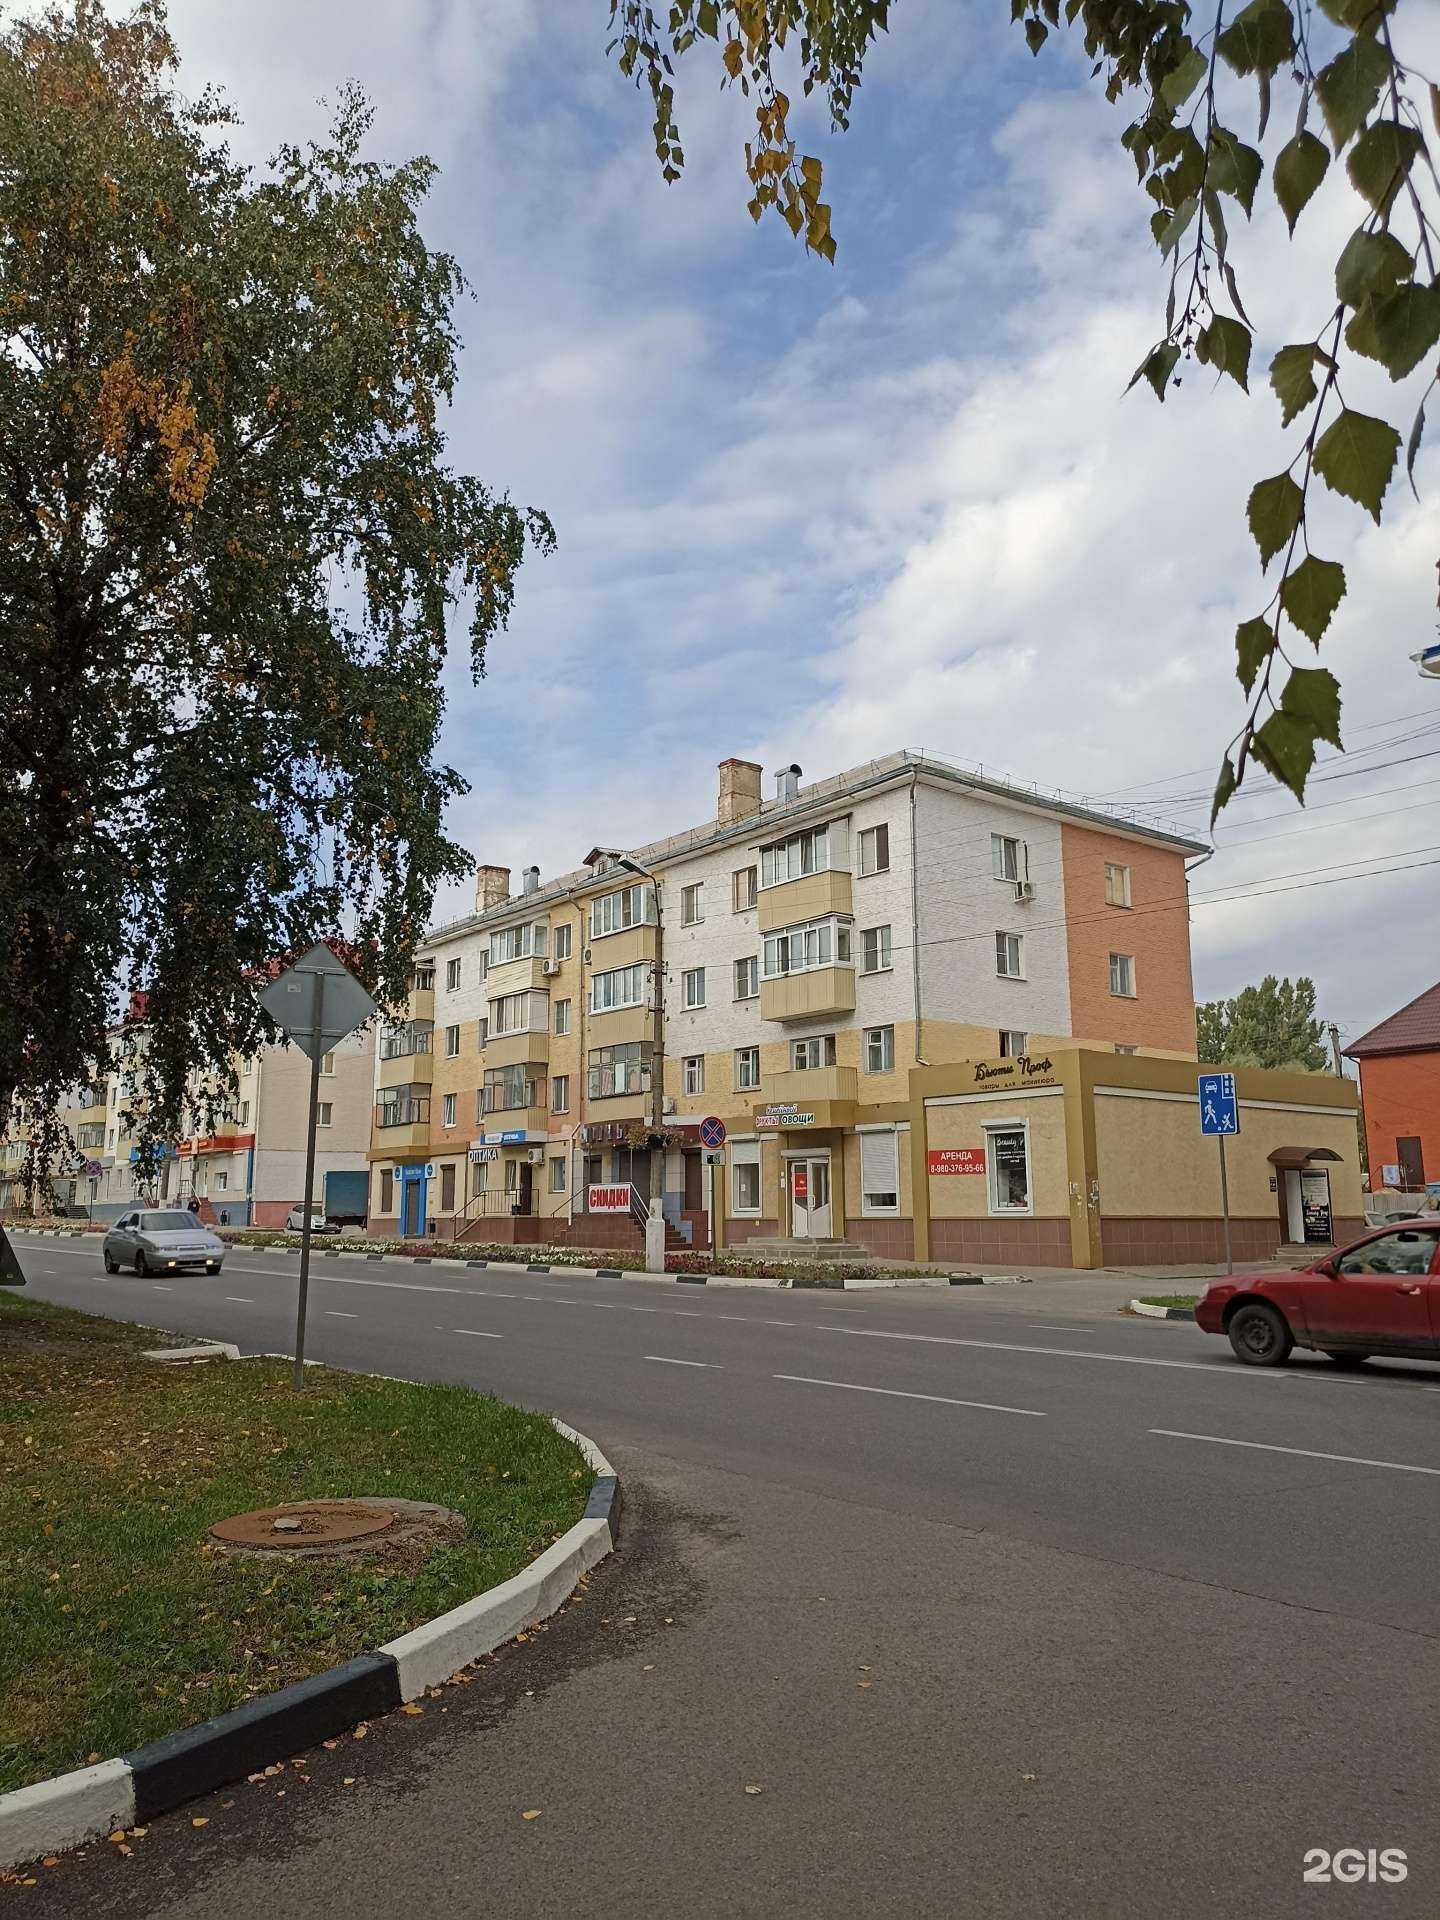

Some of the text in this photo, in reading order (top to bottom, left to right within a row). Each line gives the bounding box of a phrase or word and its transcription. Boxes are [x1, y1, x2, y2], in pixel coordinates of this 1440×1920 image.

[781, 1113, 815, 1125] ОВОЩИ
[469, 1149, 498, 1162] ОПТИКА
[940, 1151, 973, 1161] АРЕНДА
[590, 1189, 629, 1209] СКИДКИ
